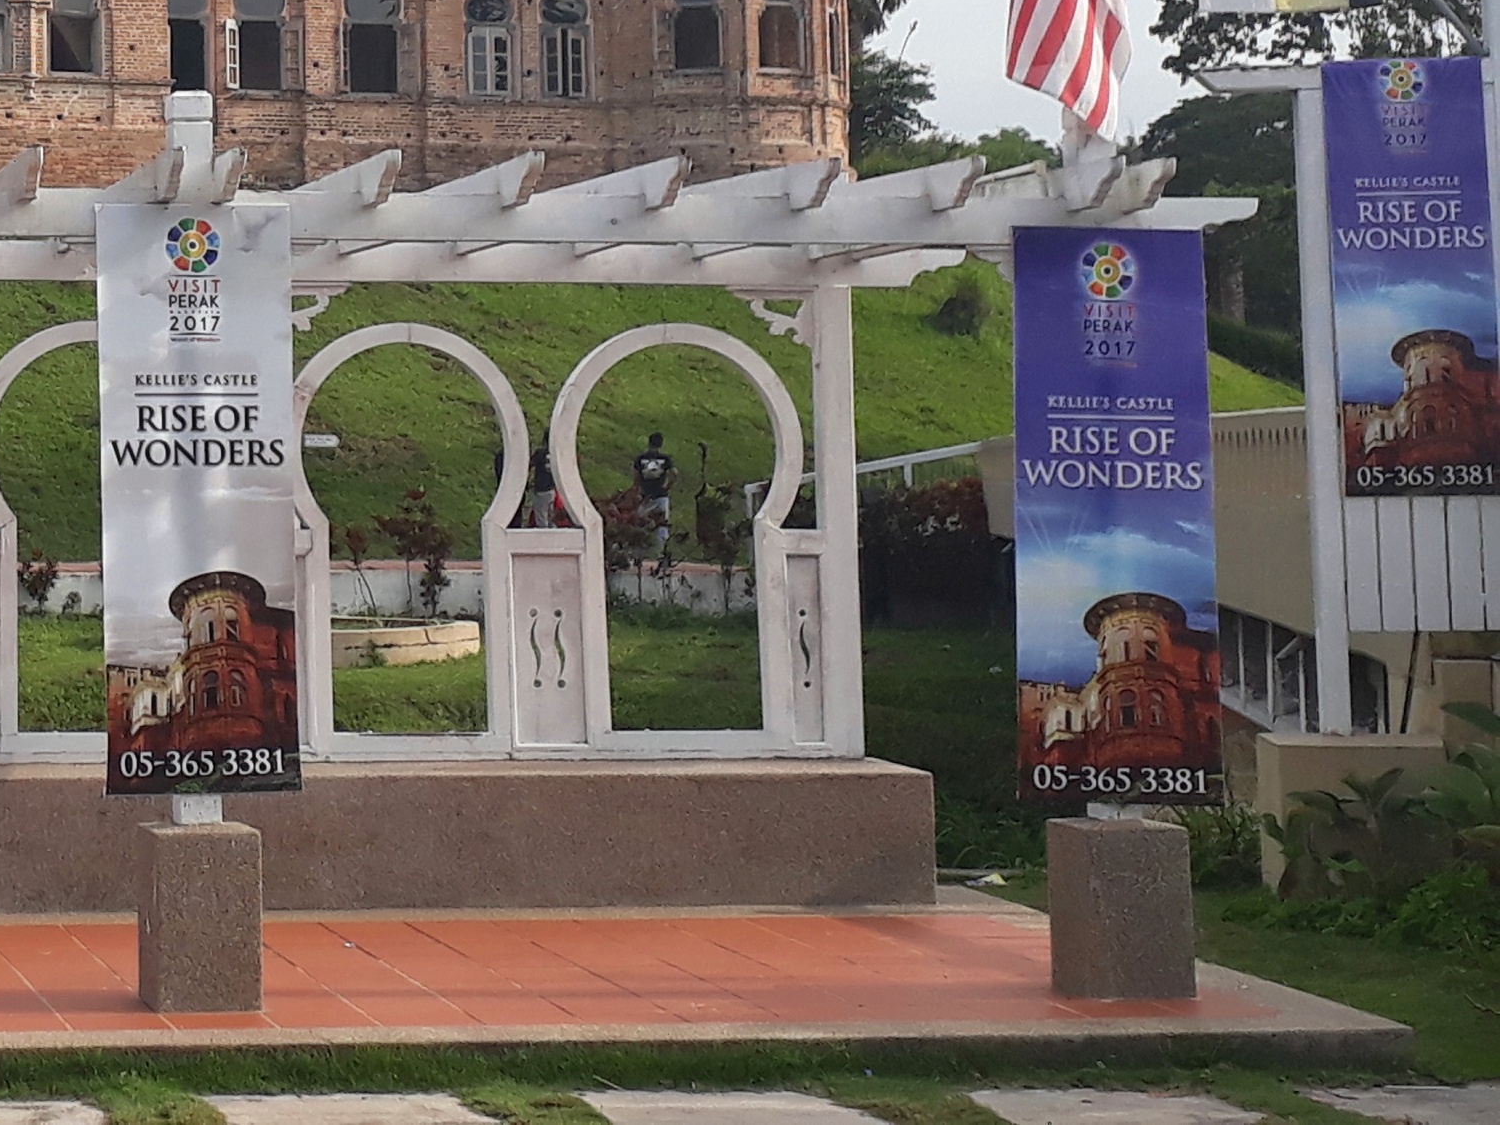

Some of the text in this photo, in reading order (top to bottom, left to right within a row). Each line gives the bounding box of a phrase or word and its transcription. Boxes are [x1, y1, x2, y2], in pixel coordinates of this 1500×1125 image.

[1384, 133, 1426, 146] 2017
[1413, 176, 1461, 187] CASTLE
[1357, 200, 1462, 224] RISE OF
[1337, 226, 1486, 251] WONDERS
[168, 279, 221, 293] VISIT
[169, 294, 219, 308] PERAK
[170, 315, 220, 331] 2017
[1084, 319, 1134, 333] PERAK
[1085, 340, 1137, 355] 2017
[134, 374, 258, 386] KELLIE'S CASTLE
[1047, 396, 1174, 411] KELLIE'S CASTLE
[136, 405, 260, 433] RISE OF
[1048, 426, 1177, 456] RISE OF
[110, 439, 285, 468] WONDERS
[1021, 459, 1204, 490] WONDERS
[1356, 463, 1495, 487] 05-365 3381
[120, 747, 285, 778] 05-365 3381
[1032, 764, 1208, 795] 05-365 3381
